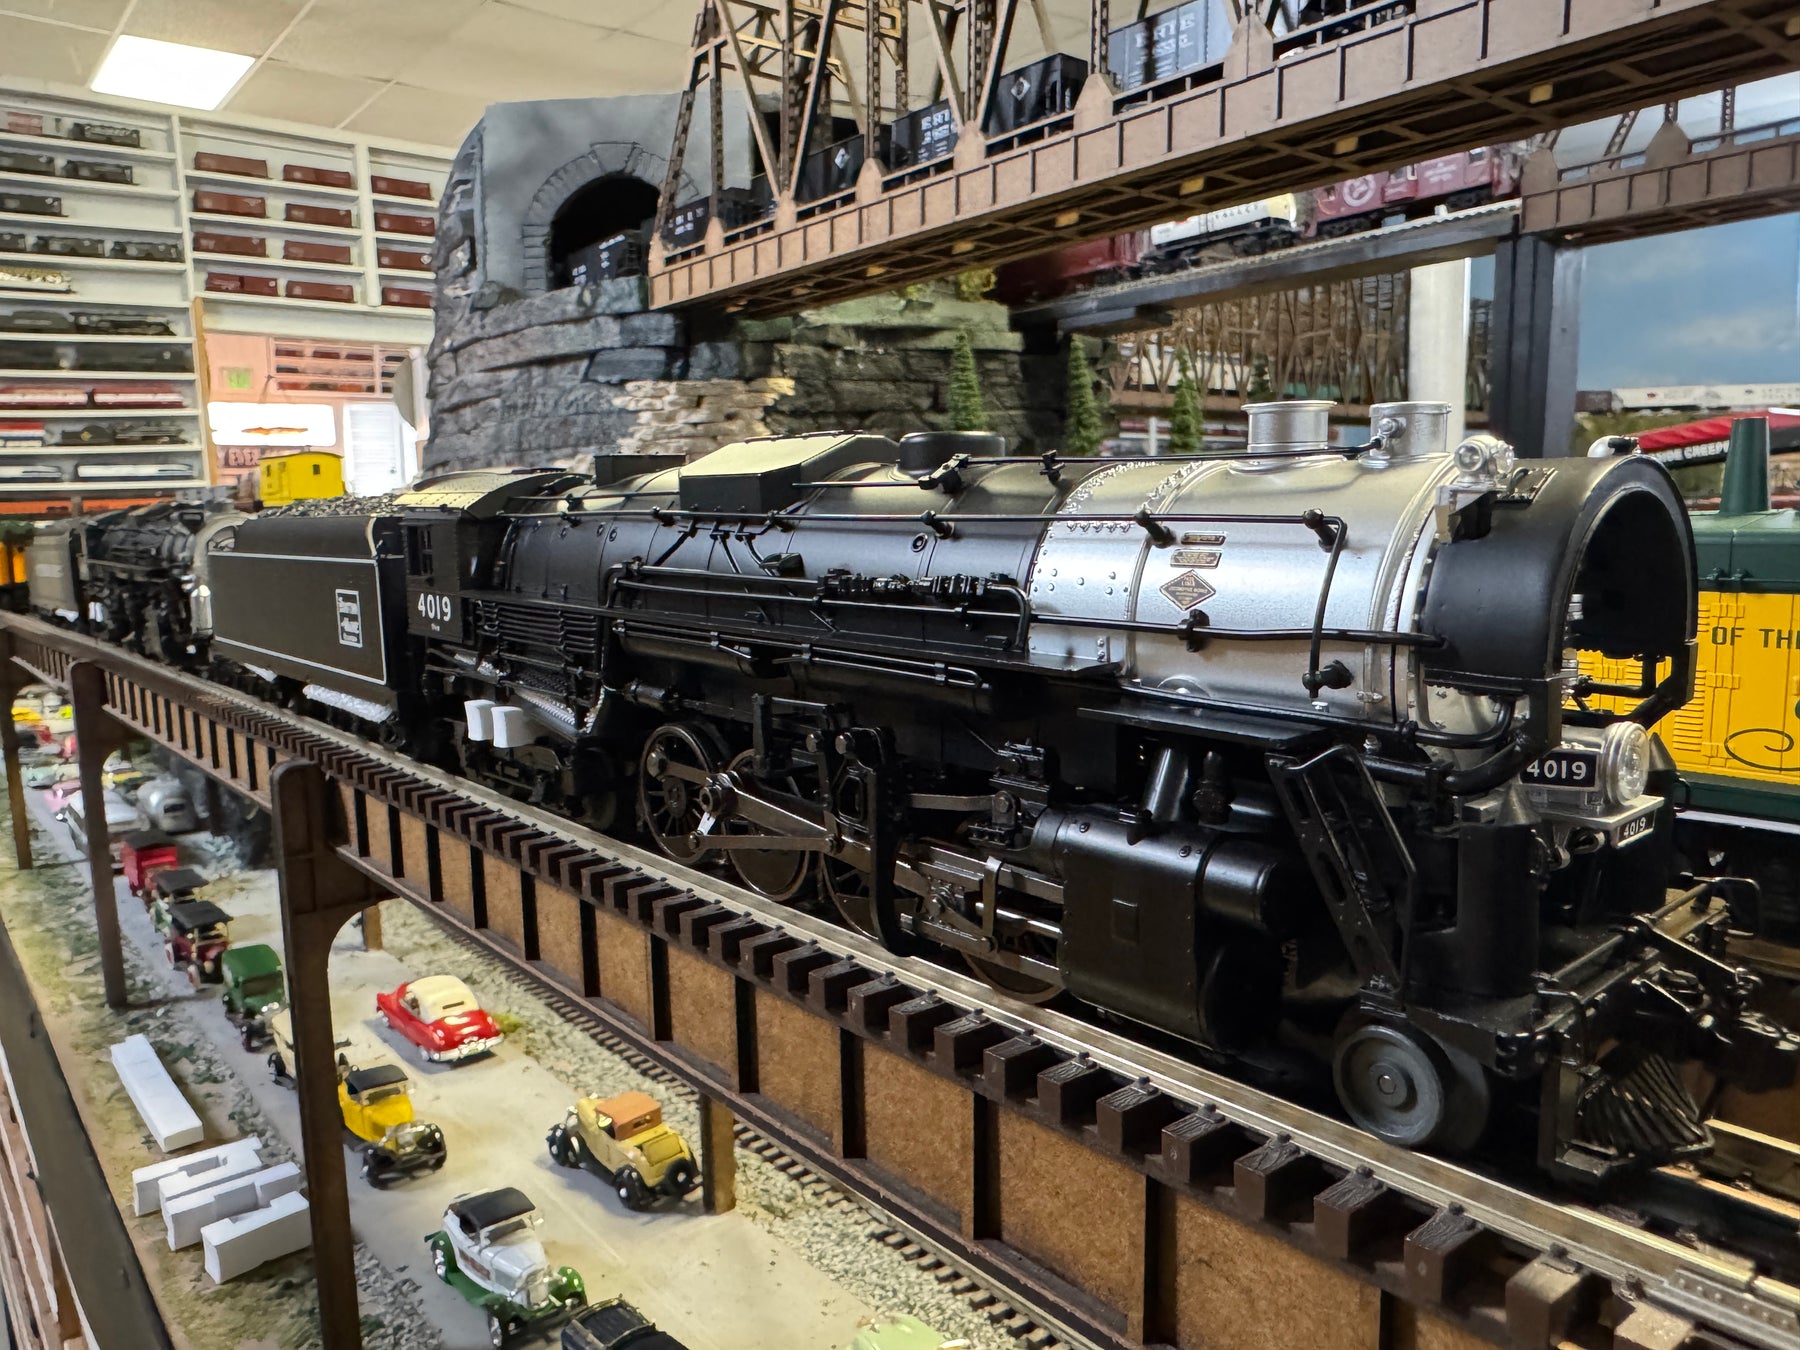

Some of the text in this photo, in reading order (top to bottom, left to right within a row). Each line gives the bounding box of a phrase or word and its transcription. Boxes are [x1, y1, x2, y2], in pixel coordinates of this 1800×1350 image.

[417, 592, 452, 622] 4019
[1711, 626, 1744, 647] OF
[1526, 759, 1587, 780] 4019
[1623, 816, 1647, 839] 4019
